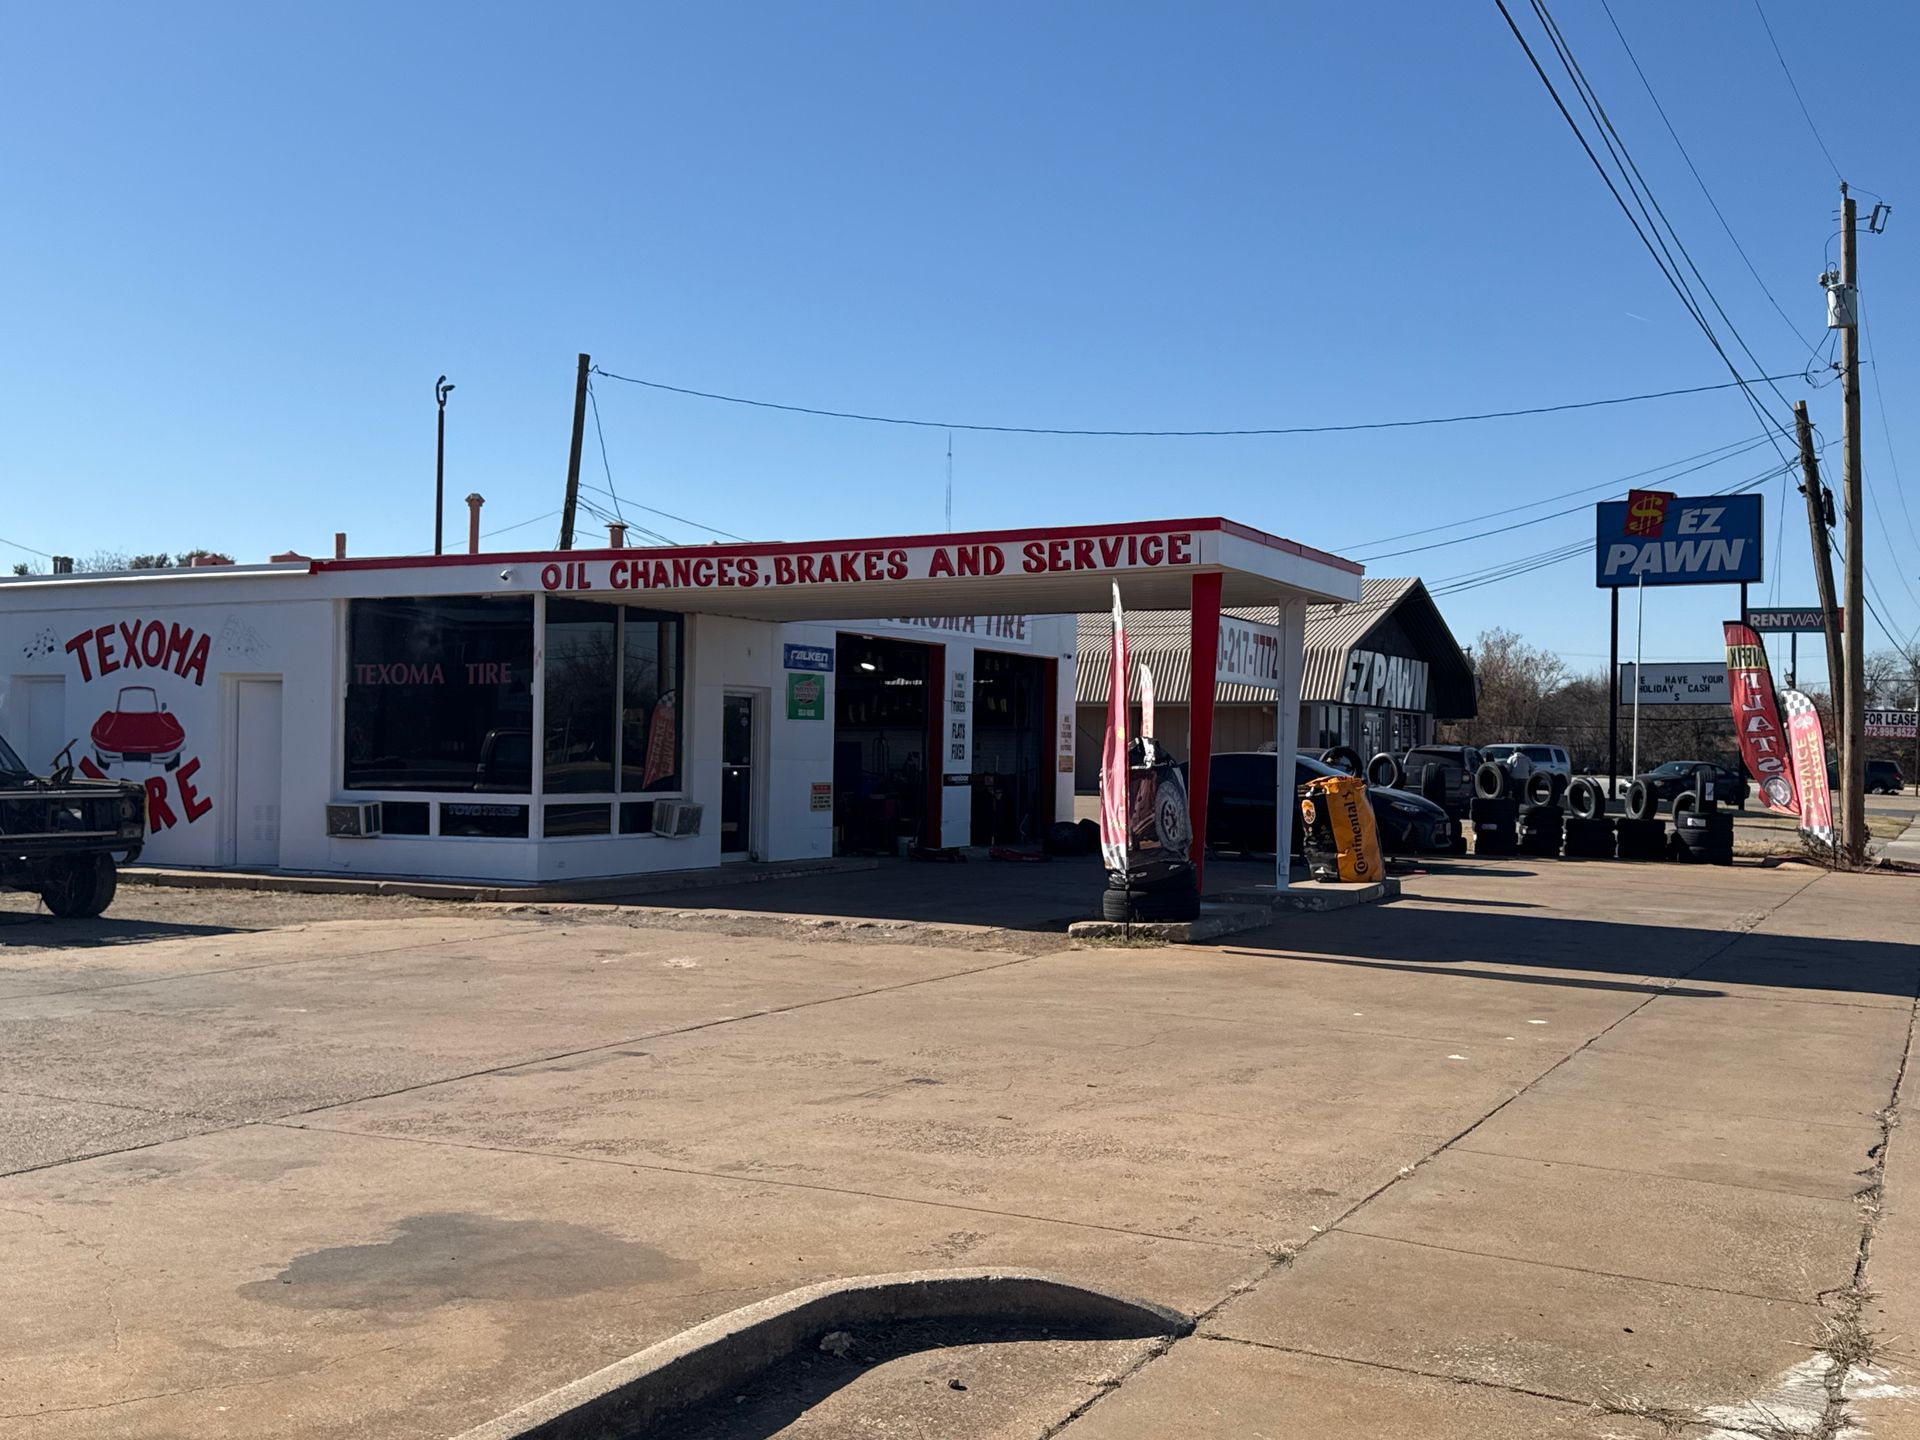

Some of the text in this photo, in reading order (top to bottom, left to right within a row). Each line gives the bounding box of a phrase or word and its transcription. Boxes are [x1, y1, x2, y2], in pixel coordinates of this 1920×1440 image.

[1677, 507, 1727, 535] EZ
[541, 562, 591, 591] OIL
[928, 545, 1005, 578] AND
[1022, 534, 1192, 573] SERVICE
[1604, 538, 1746, 576] PAWN
[65, 619, 211, 687] TEXOMA
[791, 650, 829, 662] FALKEN
[355, 663, 512, 685] TEXOMA TIRE
[1665, 675, 1689, 685] HAVE
[1702, 675, 1724, 684] YOUR
[1688, 684, 1711, 693] CASH
[1864, 713, 1917, 726] FOR LEASE
[1344, 801, 1370, 876] Continental
